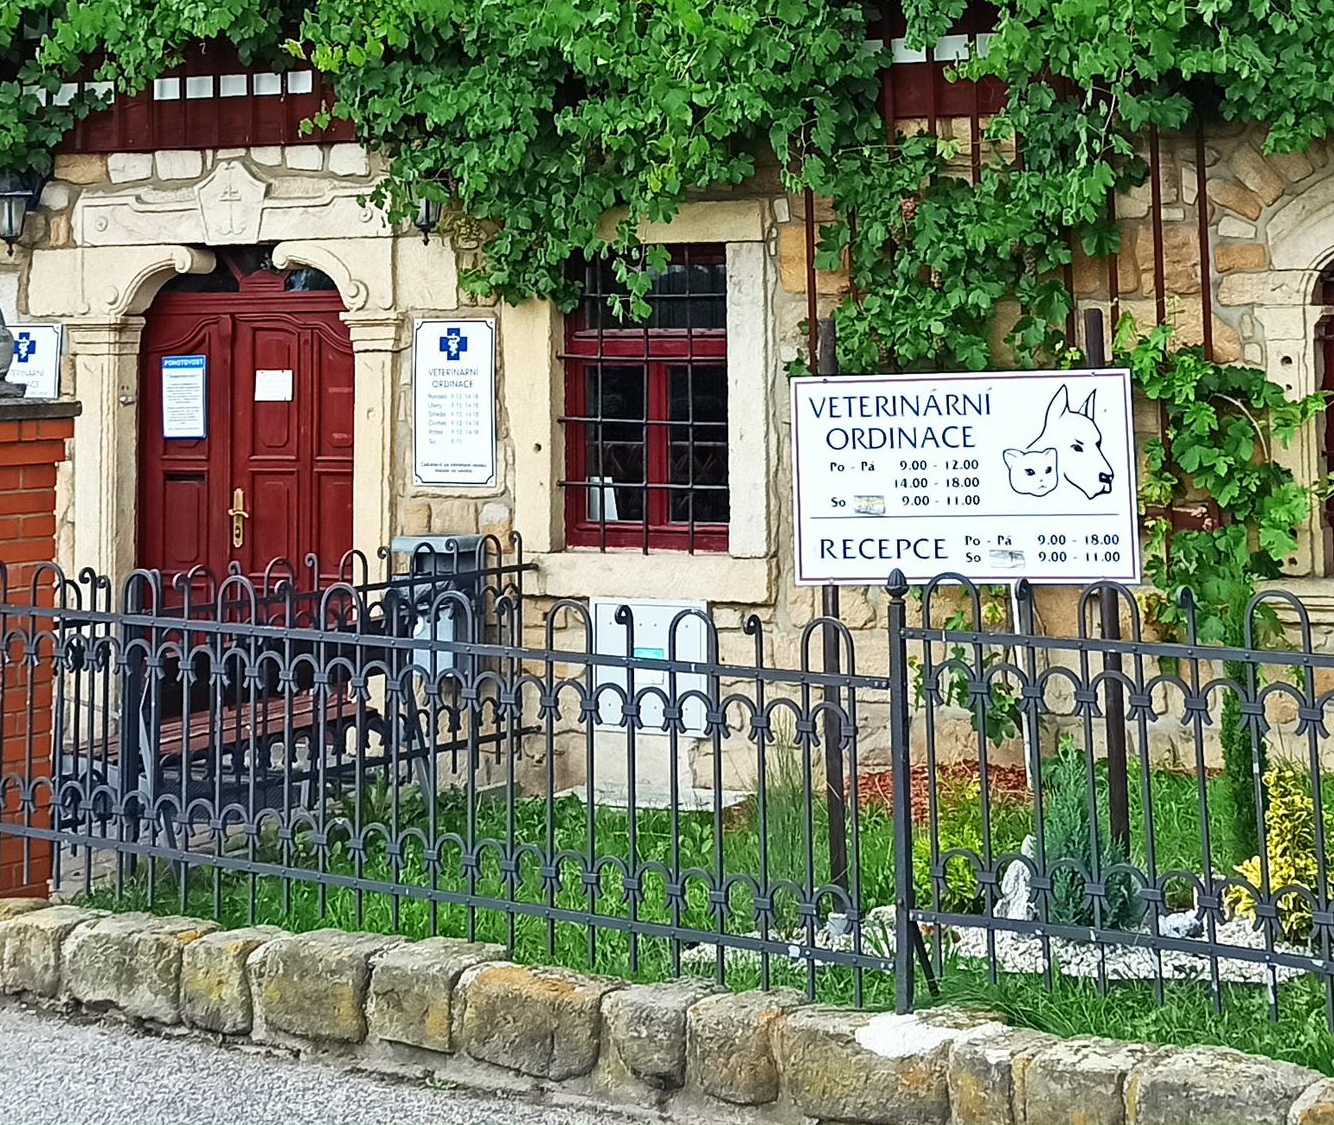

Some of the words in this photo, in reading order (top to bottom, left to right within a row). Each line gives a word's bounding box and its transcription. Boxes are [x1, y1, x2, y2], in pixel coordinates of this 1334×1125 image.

[432, 380, 473, 388] ORDINACE
[808, 387, 993, 419] VETERINÁRNÍ
[825, 425, 976, 451] ORDINACE
[830, 462, 846, 472] Po
[861, 461, 876, 472] Pá
[899, 460, 928, 471] 9.00
[945, 459, 979, 470] 12.00
[894, 477, 929, 489] 14.00
[946, 477, 980, 488] 18.00
[830, 496, 847, 508] So
[901, 495, 930, 506] 9.00
[946, 495, 981, 506] 11.00
[965, 535, 981, 546] Po
[997, 535, 1013, 546] Pá
[1037, 534, 1067, 546] 9.00
[1084, 534, 1120, 546] 18.00
[820, 537, 949, 560] RECEPCE
[965, 552, 982, 563] So
[1038, 551, 1068, 563] 9.00
[1085, 551, 1121, 563] 11.00
